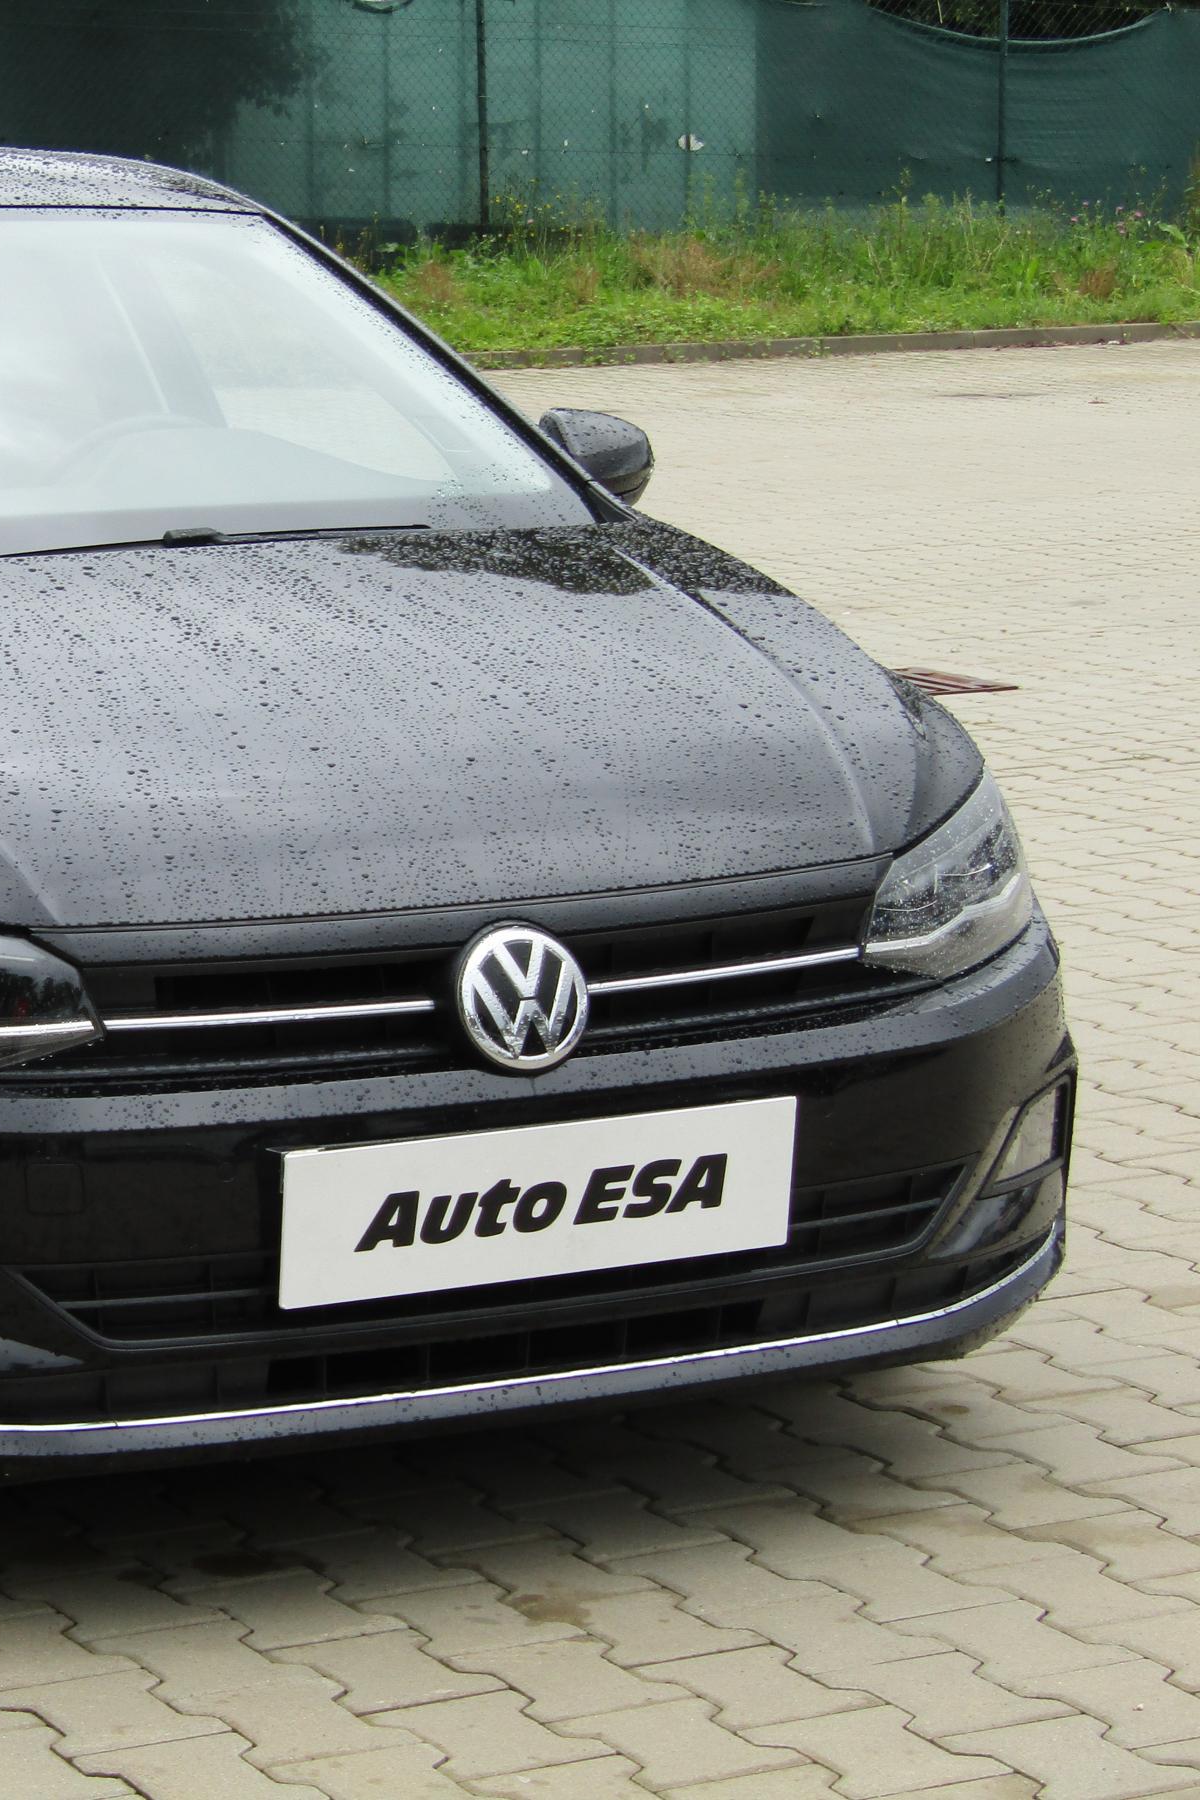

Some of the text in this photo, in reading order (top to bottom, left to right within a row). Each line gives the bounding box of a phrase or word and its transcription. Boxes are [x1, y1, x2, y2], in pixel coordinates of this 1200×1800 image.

[466, 926, 582, 1064] VW
[353, 1153, 728, 1252] Auto ESA
